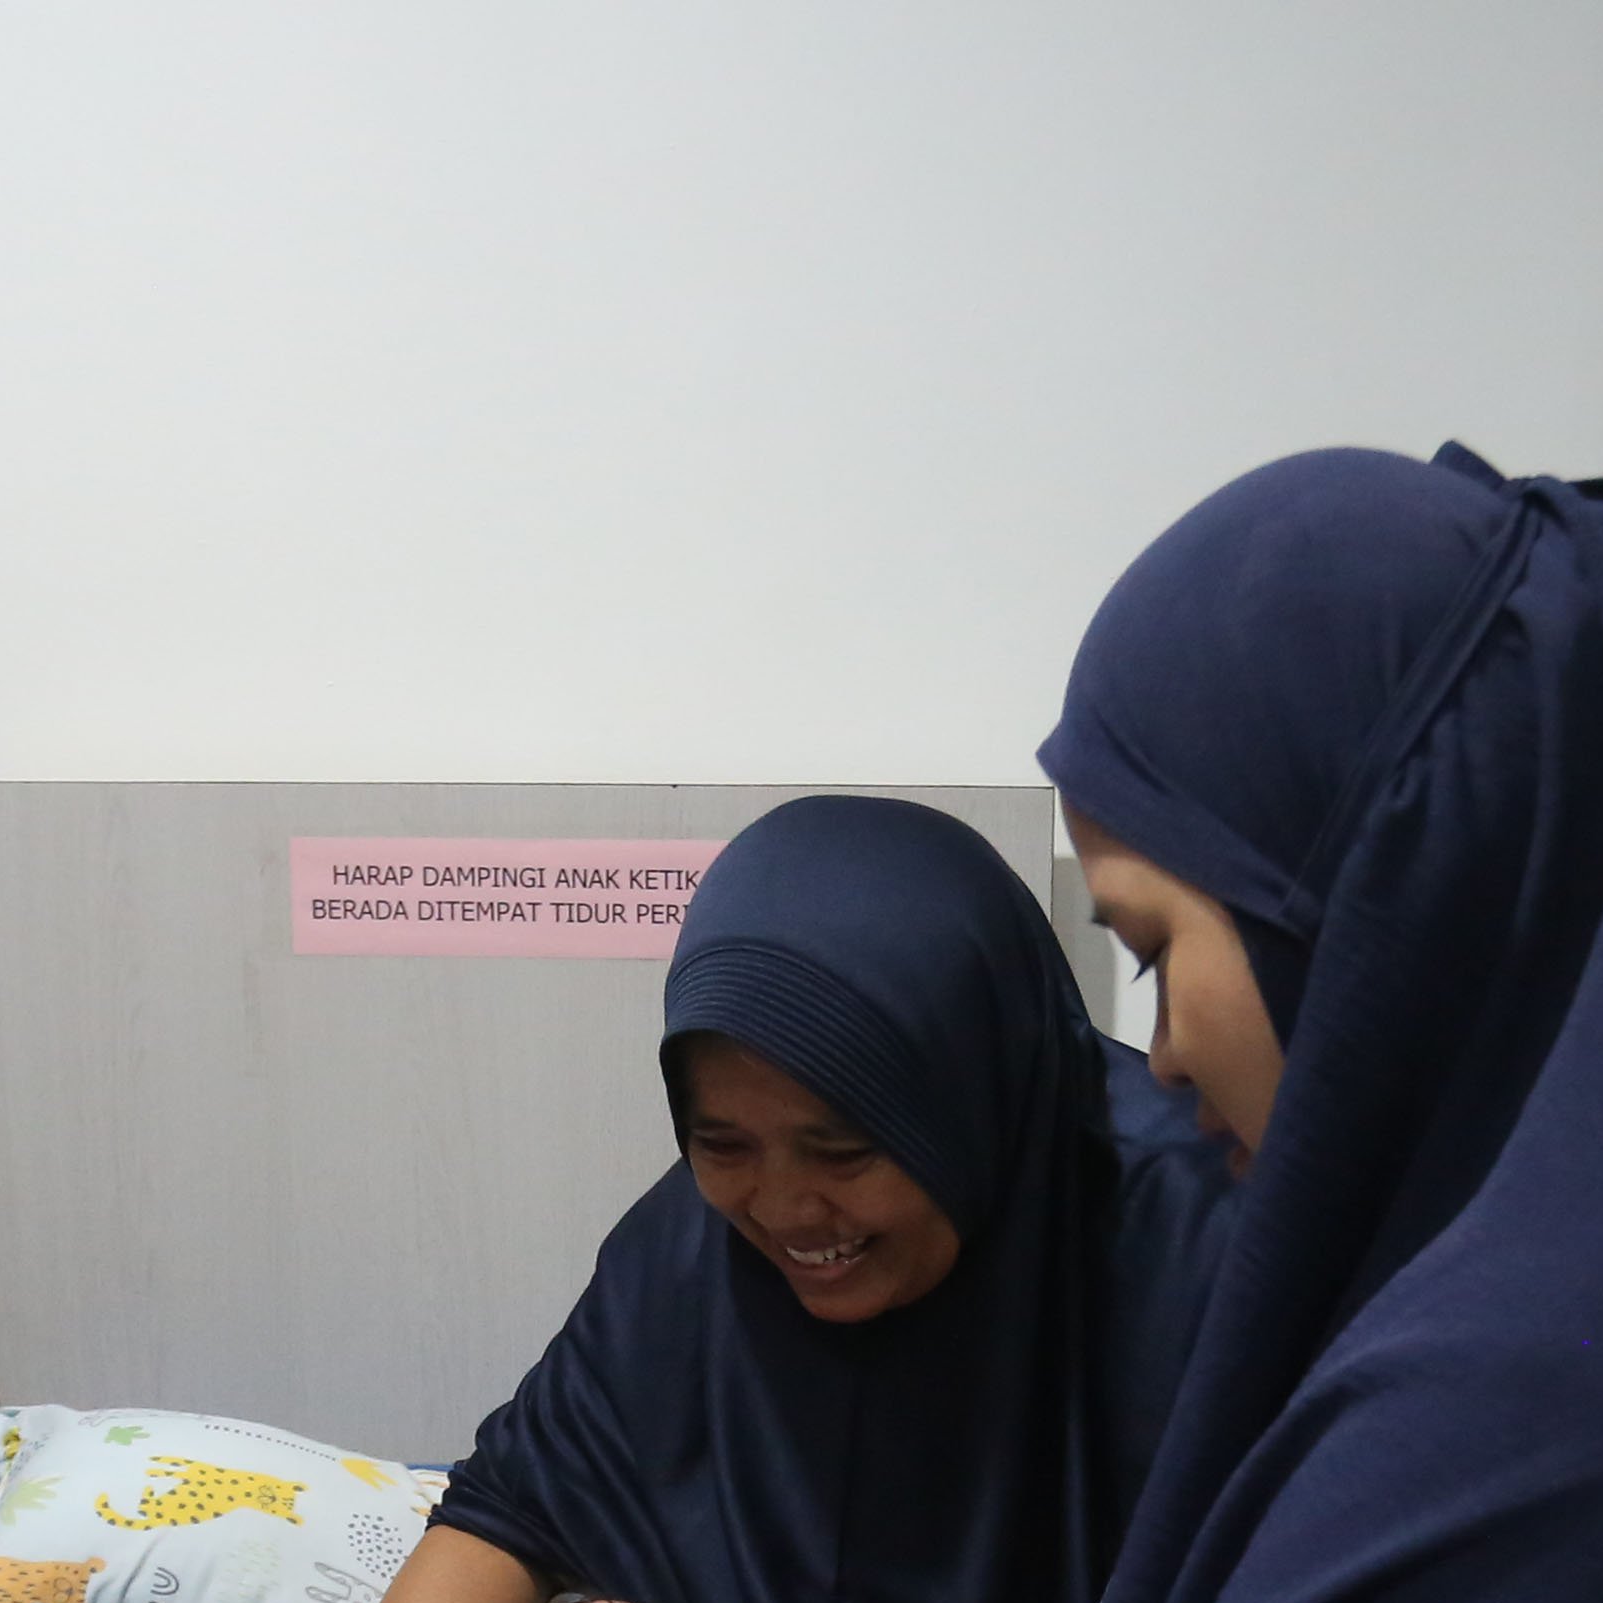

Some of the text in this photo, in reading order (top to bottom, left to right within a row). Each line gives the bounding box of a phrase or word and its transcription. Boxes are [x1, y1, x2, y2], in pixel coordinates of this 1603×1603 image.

[333, 865, 700, 890] HARAP DAMPINGI ANAK KETIK
[312, 899, 409, 920] BERADA
[418, 901, 542, 922] DITEMPAT
[550, 903, 627, 924] TIDUR
